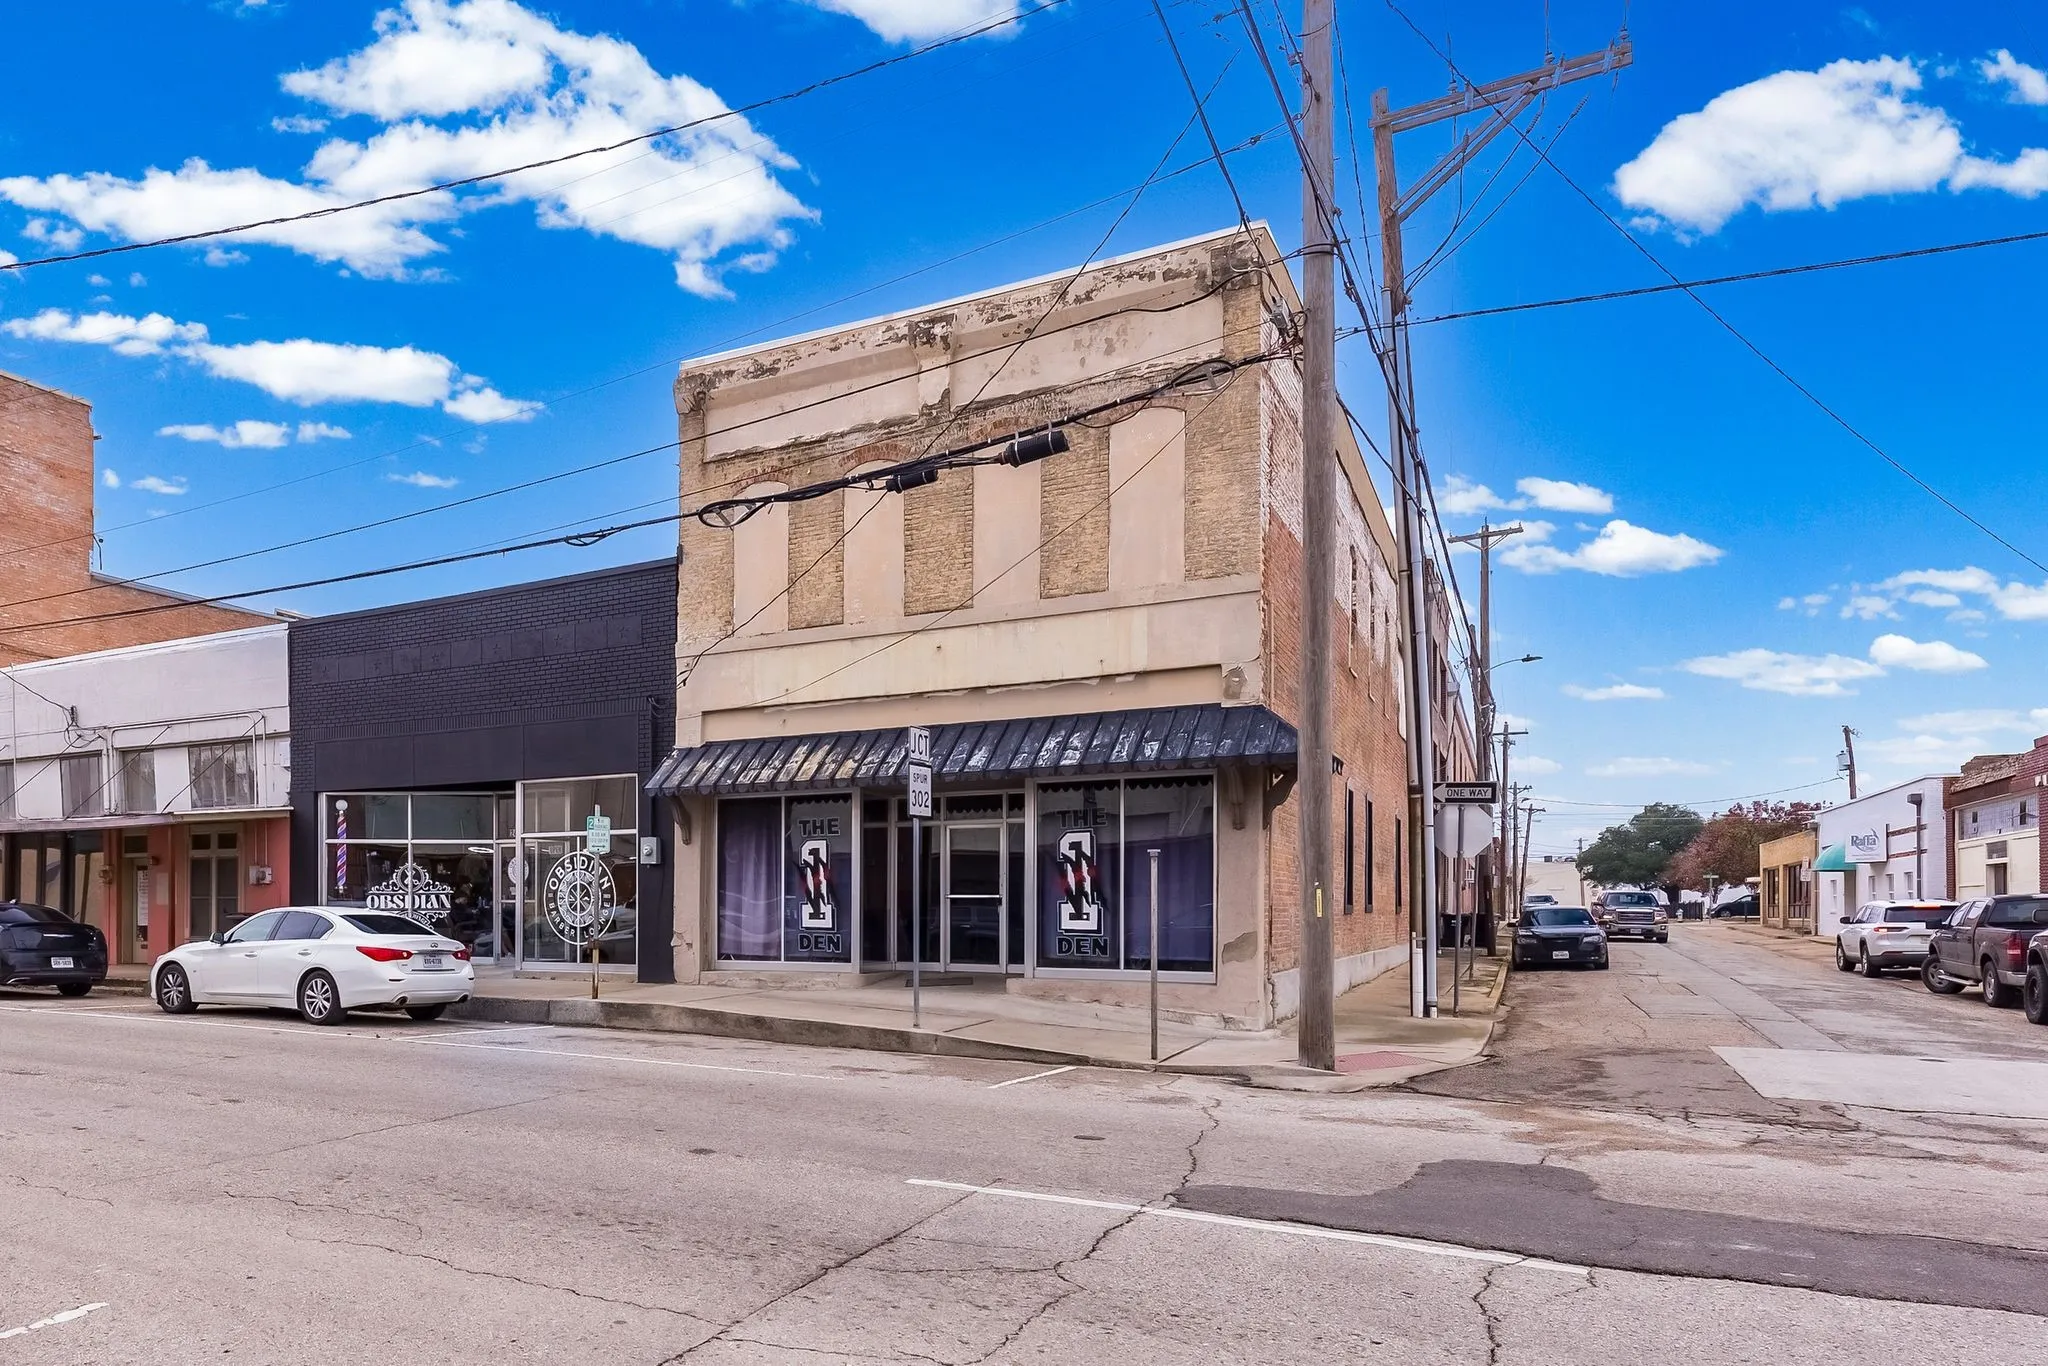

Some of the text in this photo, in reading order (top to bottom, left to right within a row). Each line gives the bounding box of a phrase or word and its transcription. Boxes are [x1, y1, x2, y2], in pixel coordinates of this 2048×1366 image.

[911, 732, 929, 757] JCT
[913, 772, 928, 784] SPUR
[912, 789, 930, 809] 302
[1447, 789, 1489, 797] ONE WAY
[798, 817, 841, 837] THE
[1056, 808, 1109, 829] THE
[366, 894, 451, 909] OBSIDIAN
[548, 901, 611, 938] BARBER LONGE
[798, 933, 842, 953] DEN
[1056, 936, 1109, 957] DEN
